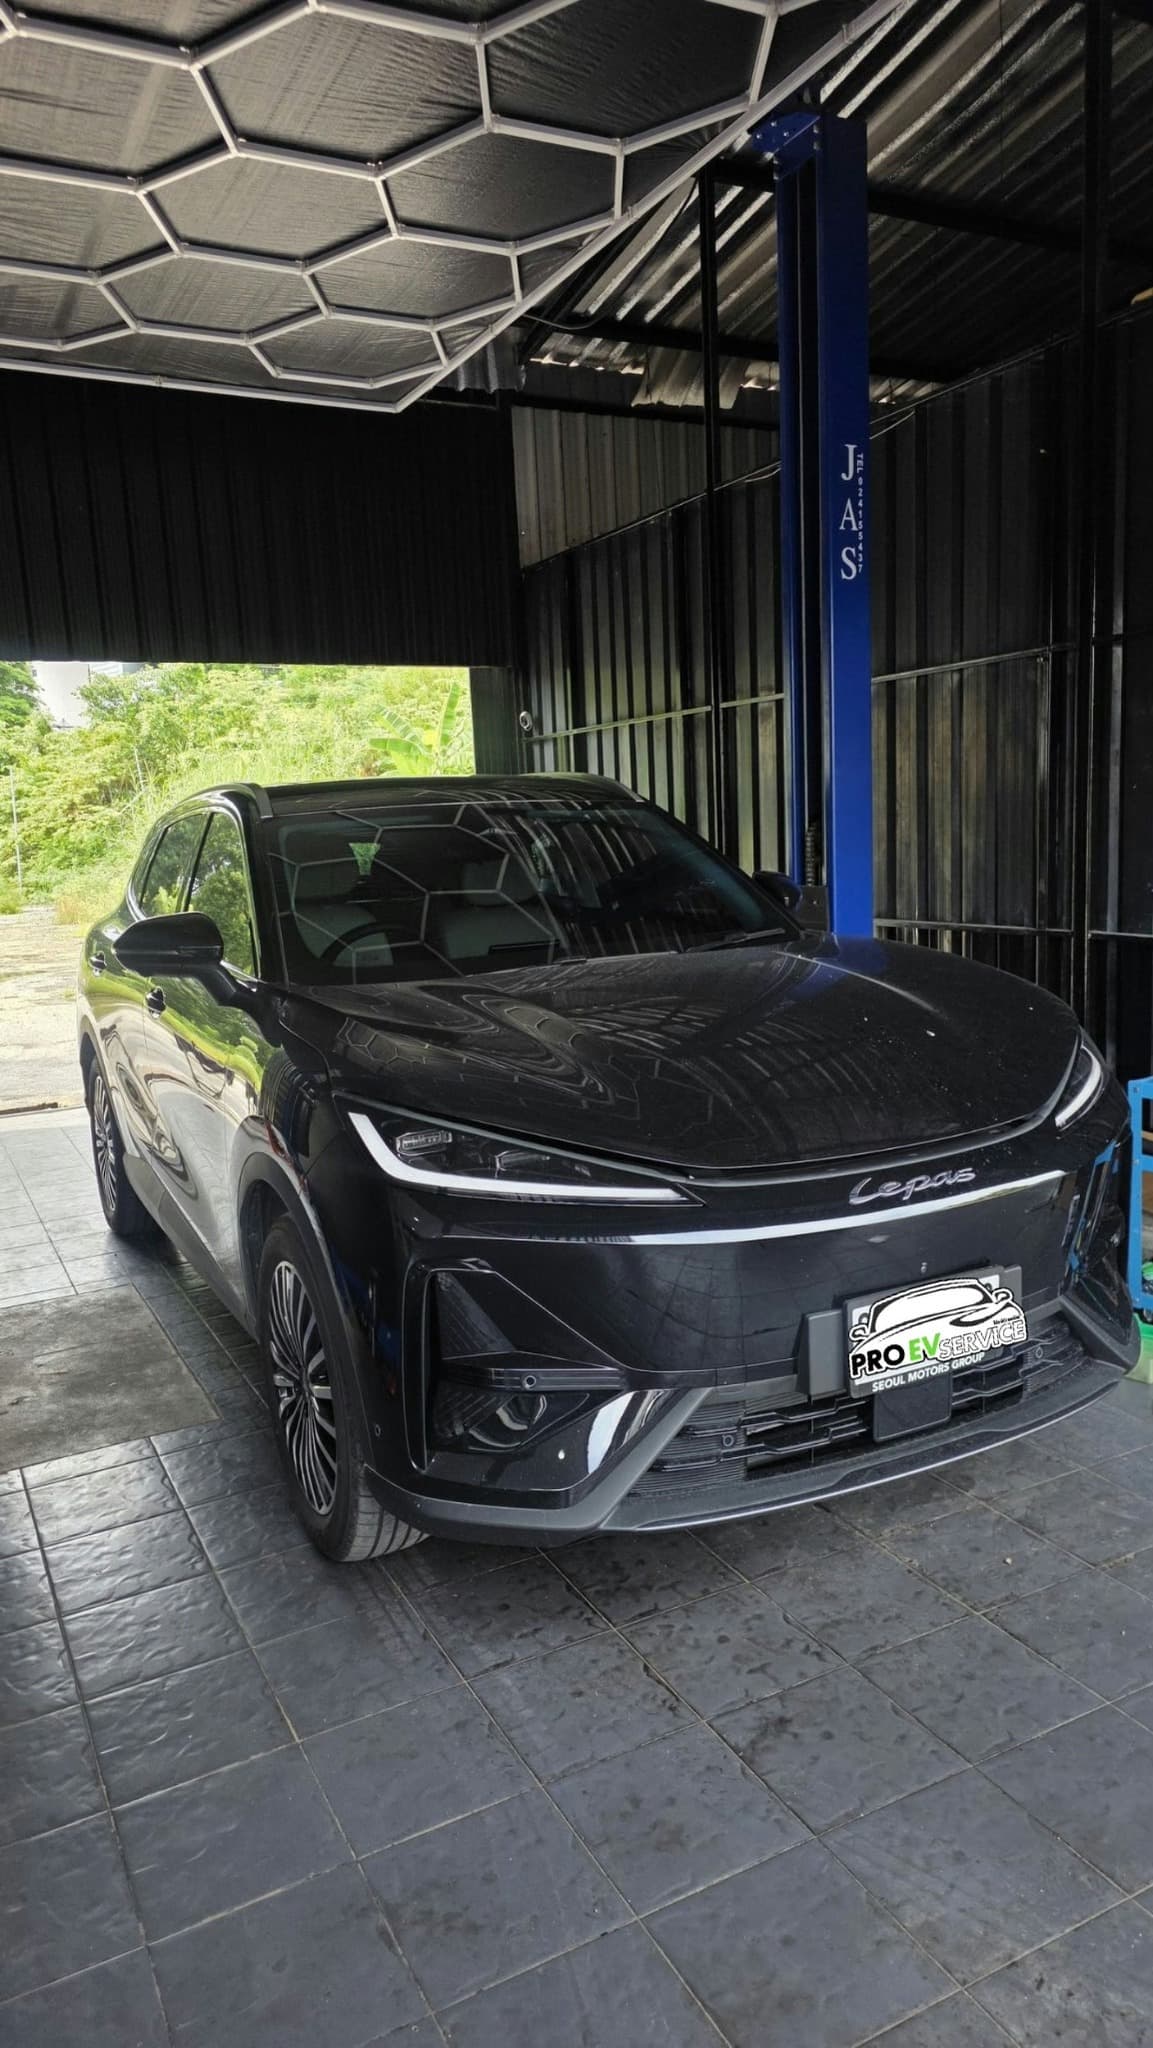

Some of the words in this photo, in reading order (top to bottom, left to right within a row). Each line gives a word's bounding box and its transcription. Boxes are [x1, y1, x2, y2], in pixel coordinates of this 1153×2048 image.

[856, 453, 864, 474] TEL
[839, 443, 859, 580] JAS
[848, 1167, 977, 1206] Lepas
